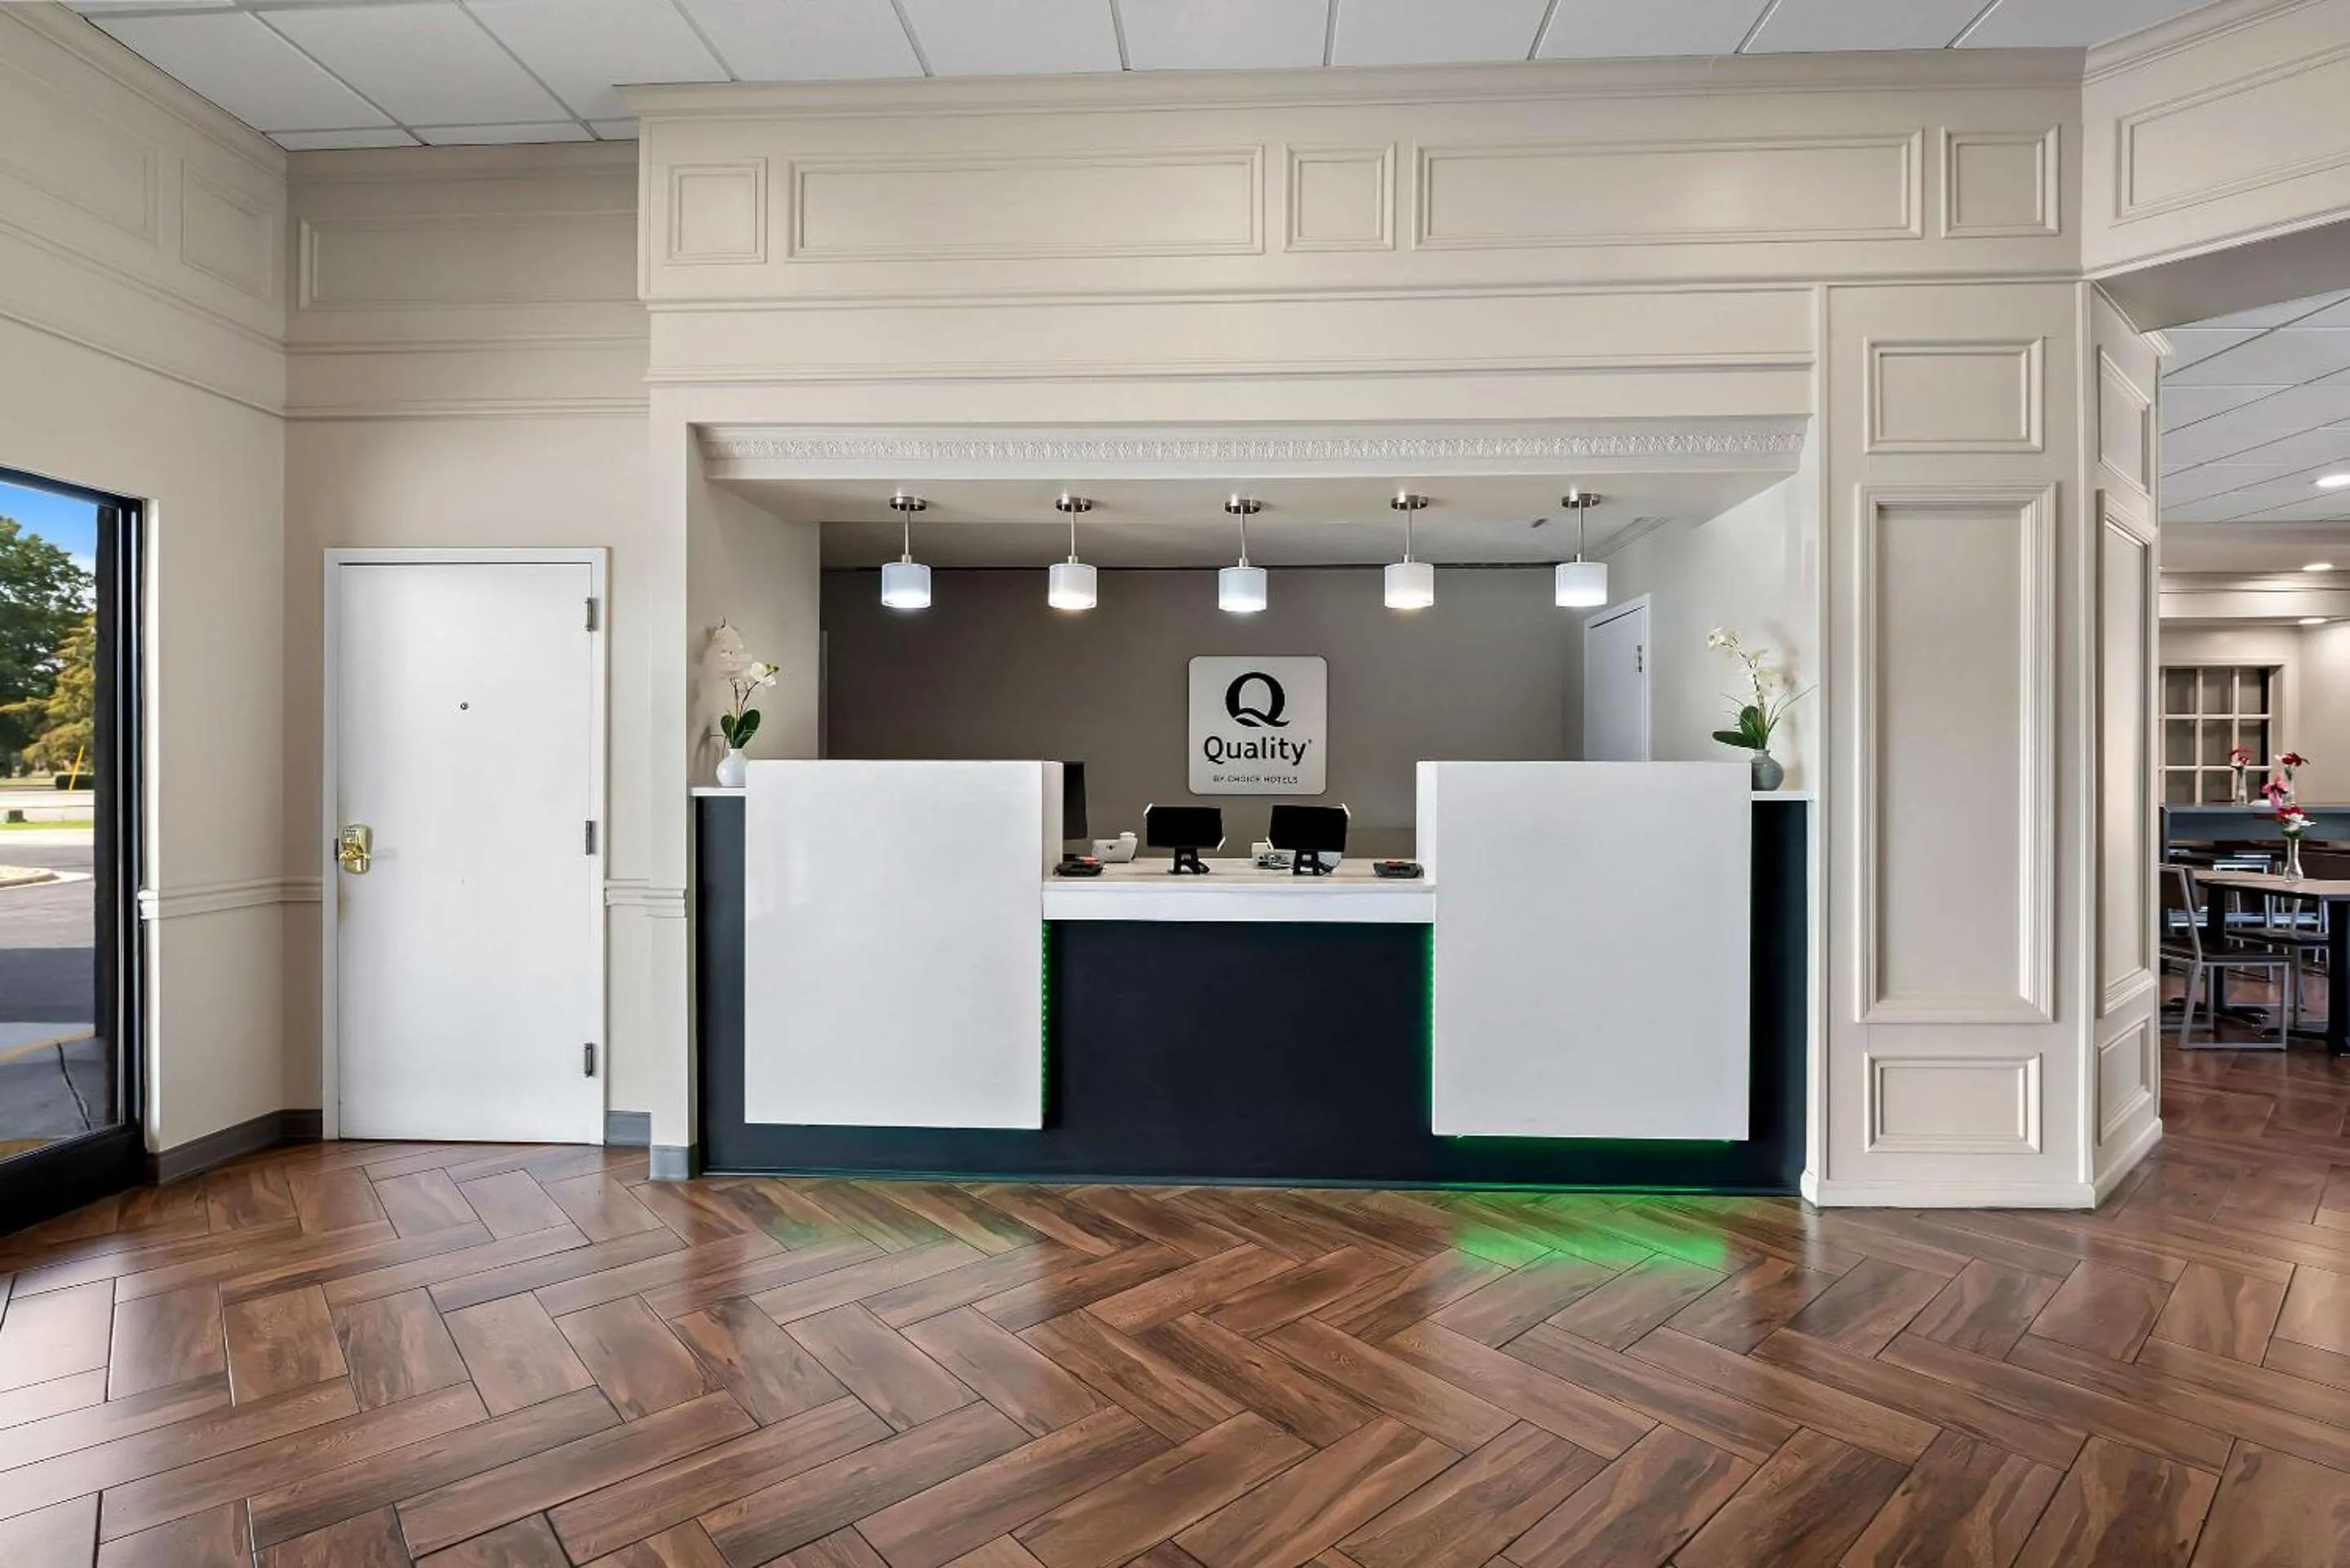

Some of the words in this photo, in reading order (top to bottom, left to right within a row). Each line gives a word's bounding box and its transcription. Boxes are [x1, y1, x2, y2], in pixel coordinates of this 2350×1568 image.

[1225, 672, 1290, 727] Q
[1204, 735, 1307, 766] Quality
[1213, 775, 1224, 783] BY
[1228, 775, 1260, 784] CHOICE
[1264, 775, 1298, 784] HOTELS
